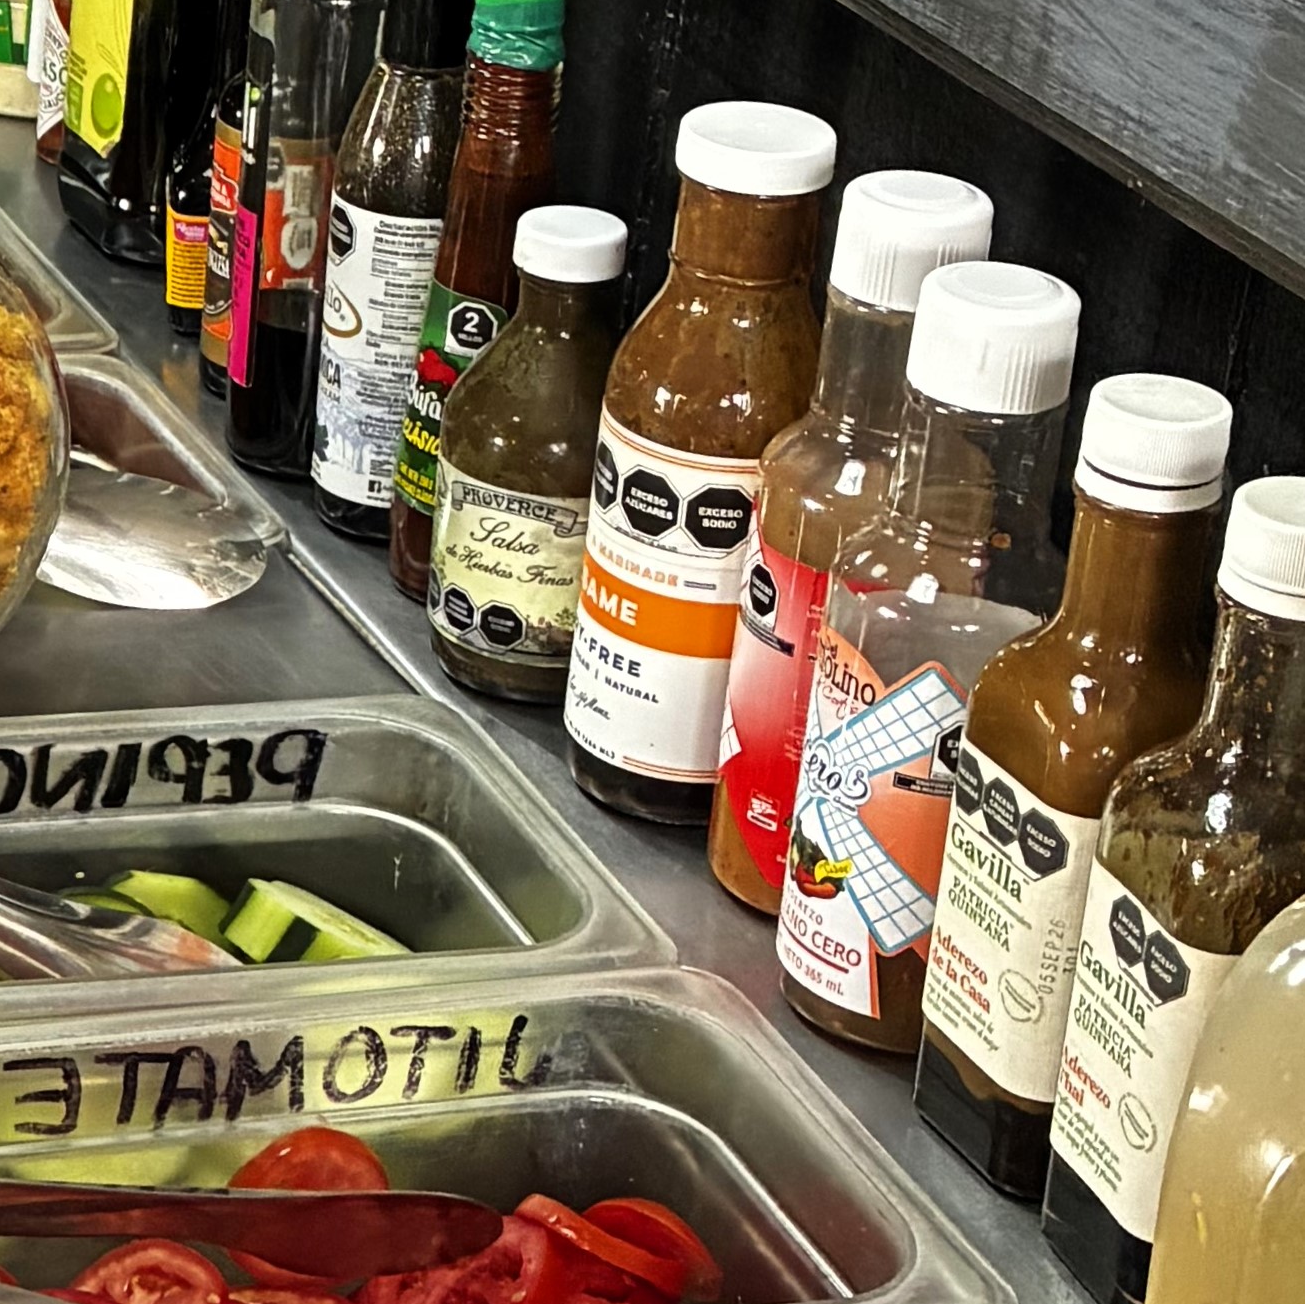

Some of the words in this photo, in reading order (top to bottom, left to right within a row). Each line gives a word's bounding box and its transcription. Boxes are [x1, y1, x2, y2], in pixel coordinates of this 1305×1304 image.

[463, 311, 481, 334] 2
[629, 486, 670, 508] EXCESO
[697, 506, 744, 519] EXCESO
[470, 517, 541, 556] Salsa
[701, 519, 738, 530] SODIO
[445, 543, 458, 558] de
[516, 564, 575, 587] Finas
[604, 675, 660, 704] NATURAL
[1026, 823, 1057, 848] EXCESO
[951, 822, 1022, 903] Gavilla
[948, 888, 1010, 952] QUINTANA
[953, 875, 1010, 935] PATRICIA
[811, 929, 862, 967] CERO
[935, 925, 988, 985] Aderezo
[946, 959, 958, 983] la
[960, 975, 991, 1014] Casa
[1080, 939, 1145, 1030] Gavilla
[1074, 1006, 1132, 1079] QUINTANA
[1078, 993, 1132, 1061] PATRICIA
